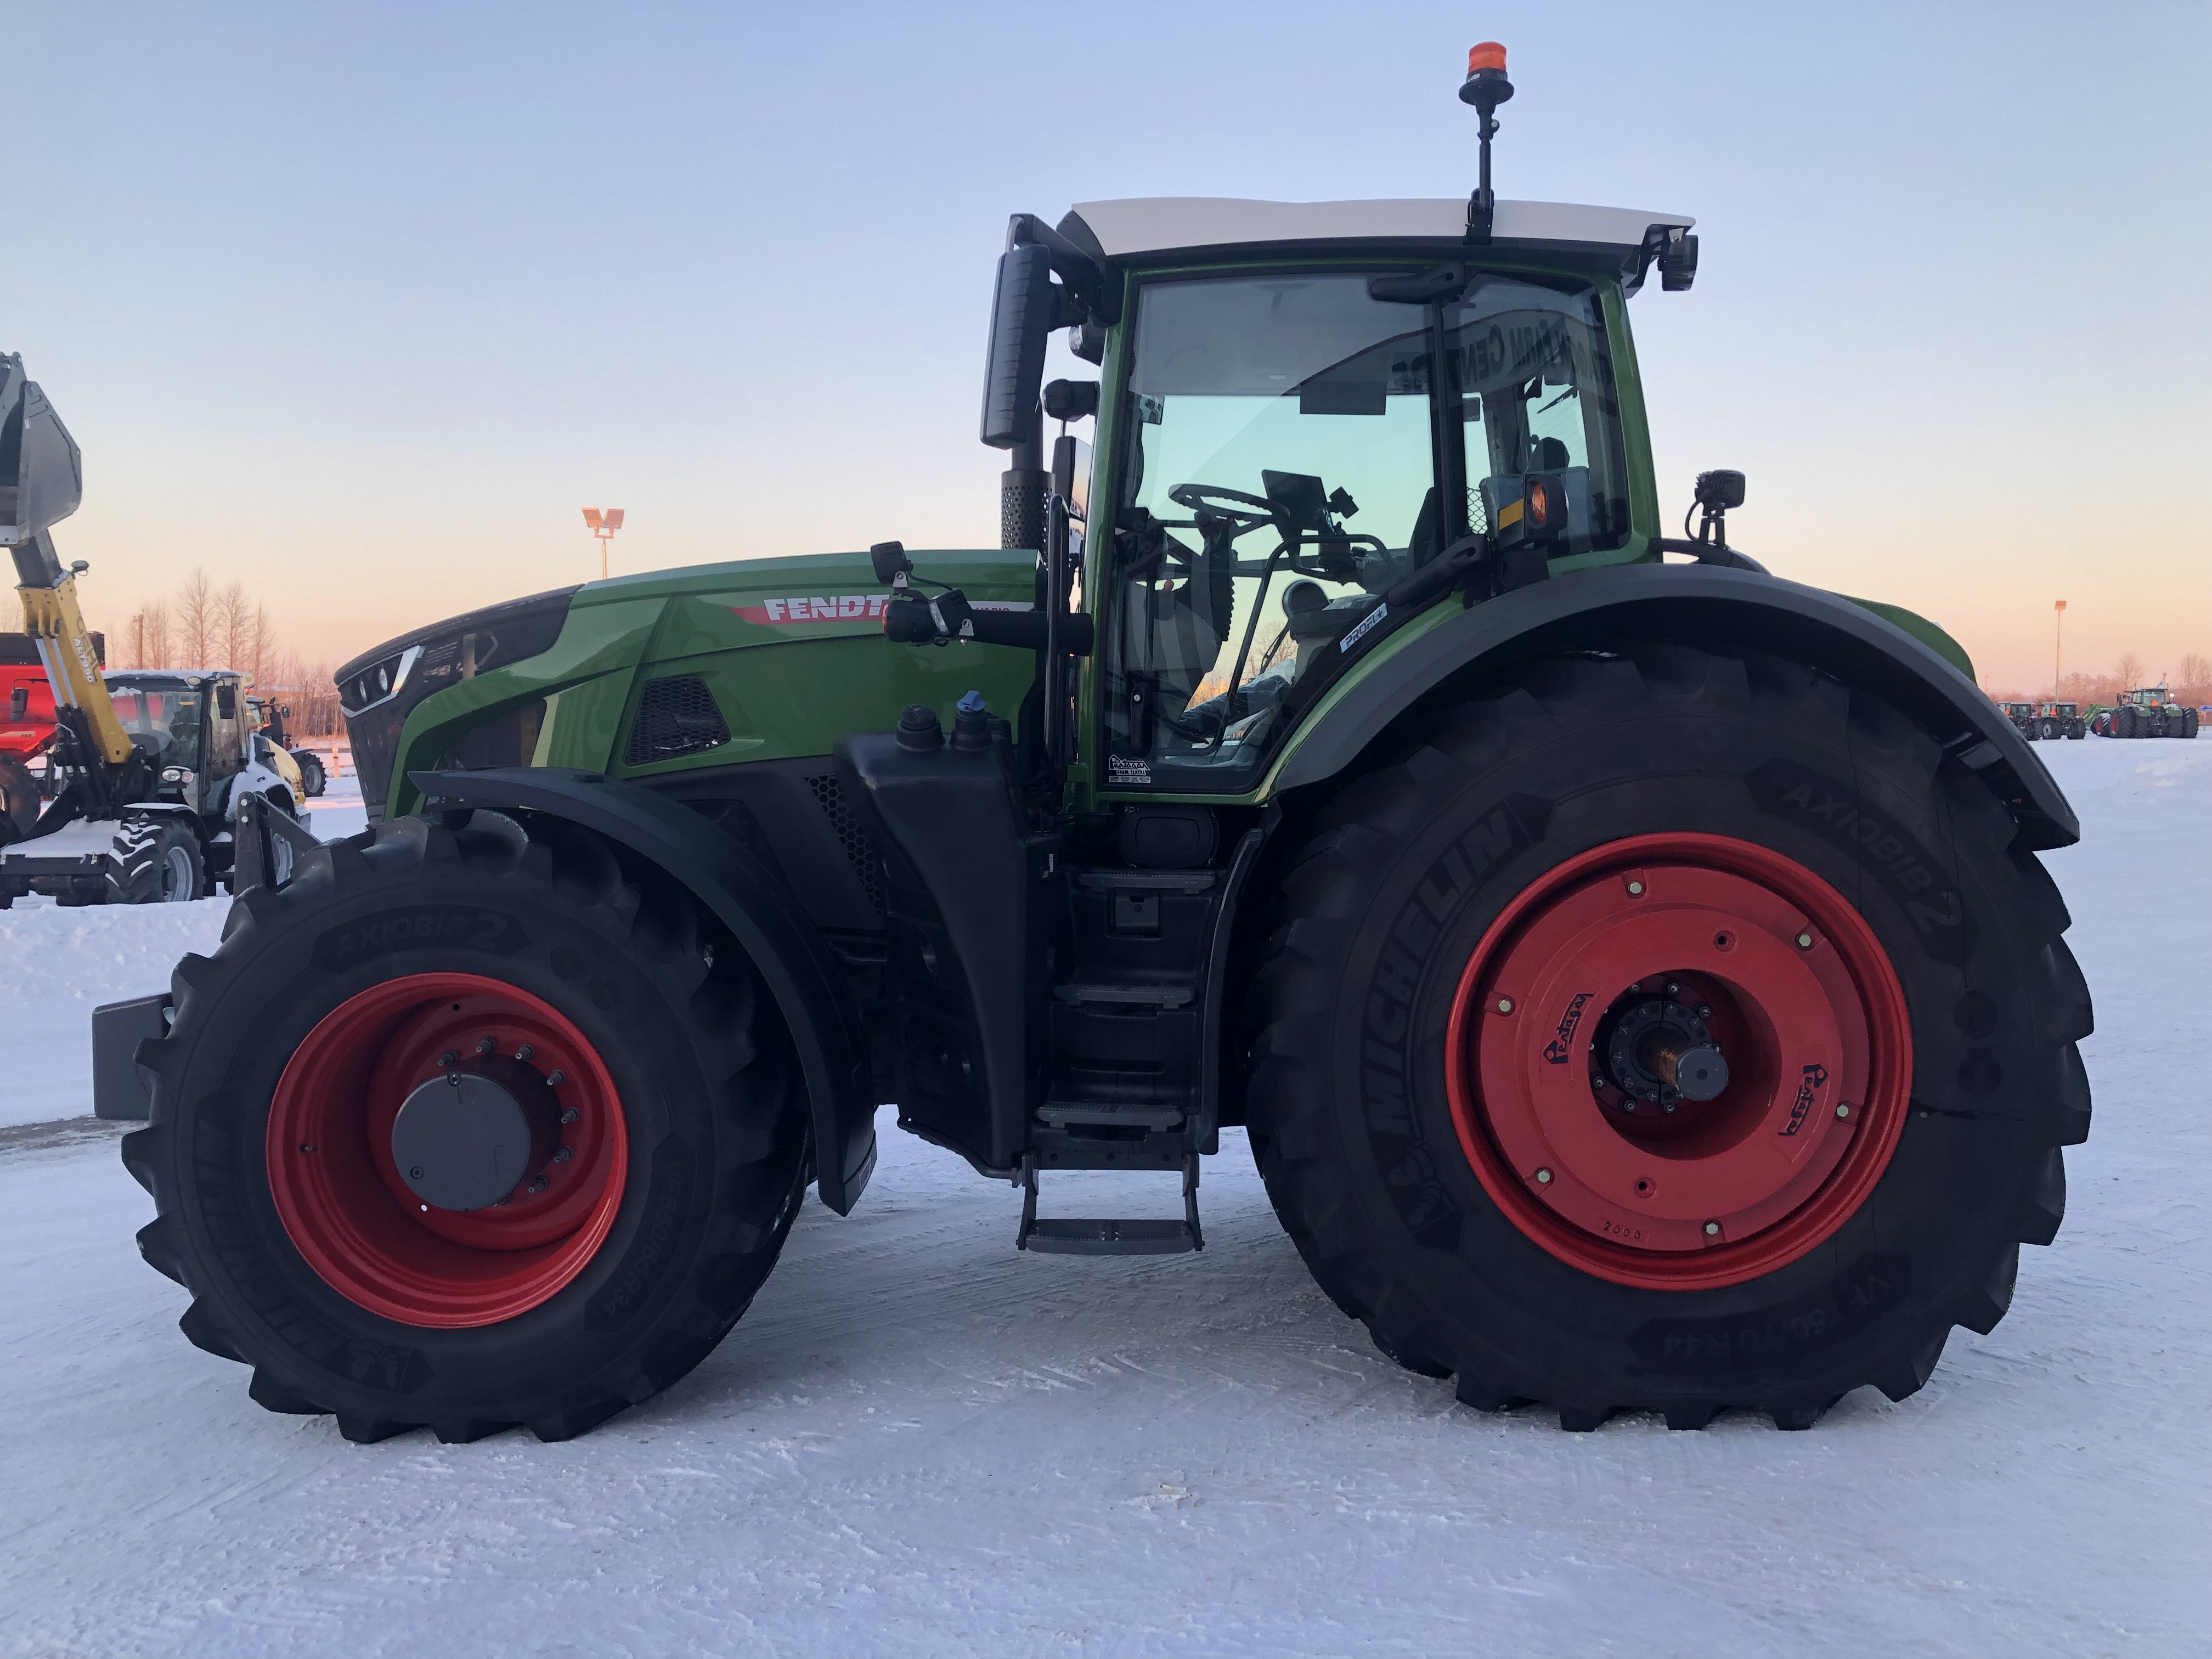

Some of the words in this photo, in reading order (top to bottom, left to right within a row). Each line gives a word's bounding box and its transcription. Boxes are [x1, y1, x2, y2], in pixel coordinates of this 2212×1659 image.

[763, 594, 890, 620] FENDT
[1346, 610, 1383, 647] PROFI+
[1782, 782, 1933, 891] AXIOBIB
[1903, 890, 1963, 933] 2
[337, 915, 469, 960] AXIOBIB
[467, 912, 507, 950] 2
[1365, 808, 1513, 1136] MICHELIN
[1603, 1221, 1640, 1240] 2000
